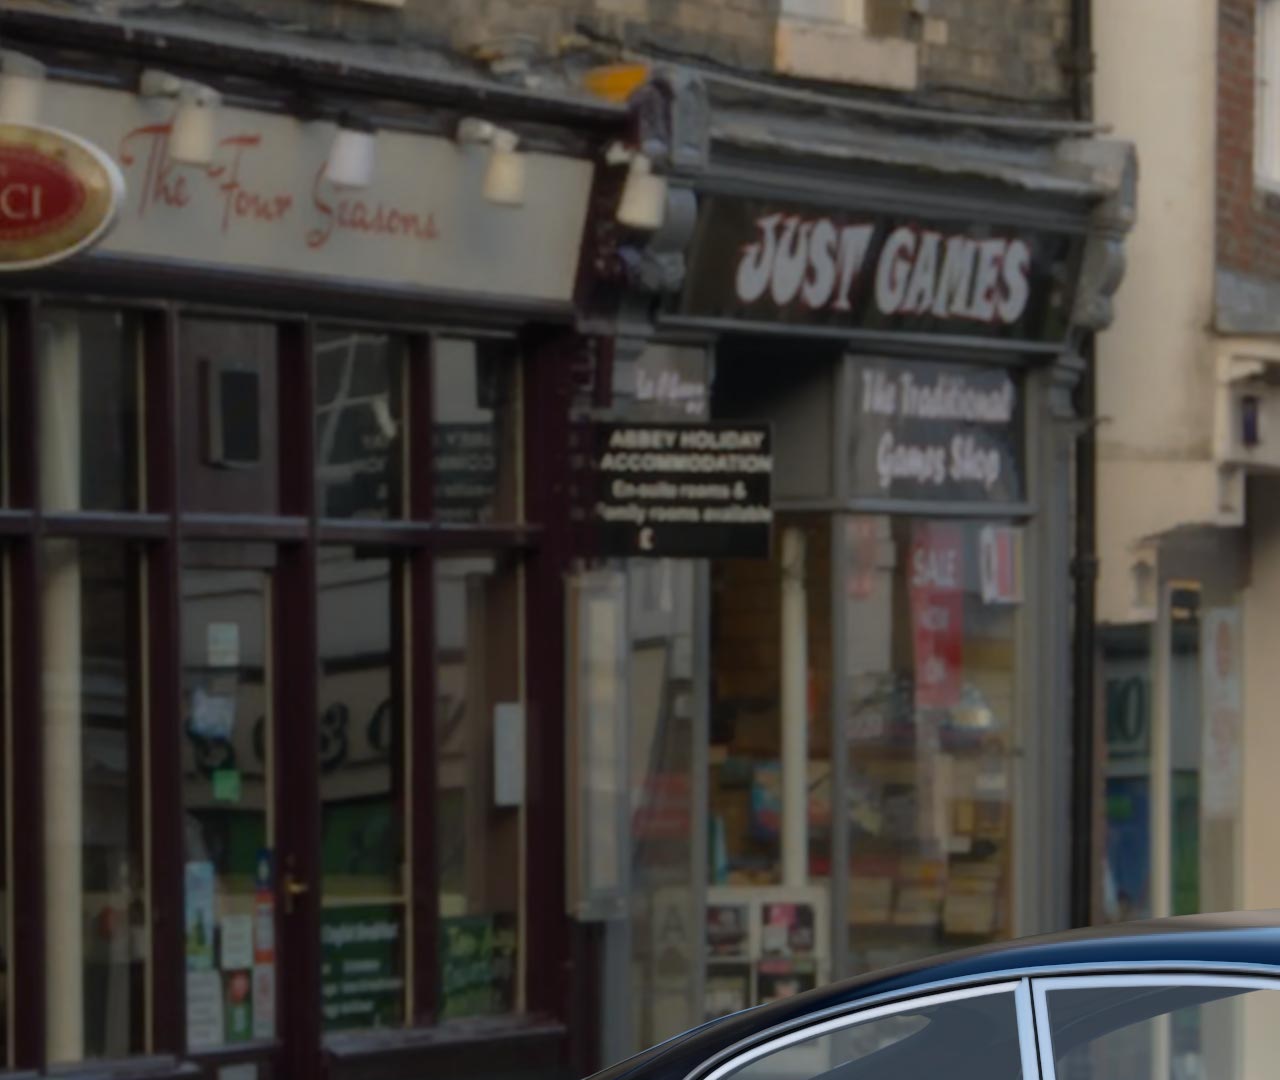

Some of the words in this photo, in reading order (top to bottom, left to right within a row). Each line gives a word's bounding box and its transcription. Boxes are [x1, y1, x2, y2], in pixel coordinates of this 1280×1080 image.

[304, 158, 440, 250] Seasons
[736, 211, 874, 311] JUST
[874, 226, 1032, 324] GAMES
[609, 428, 677, 449] ABBEY
[679, 429, 766, 450] HOLIDAY
